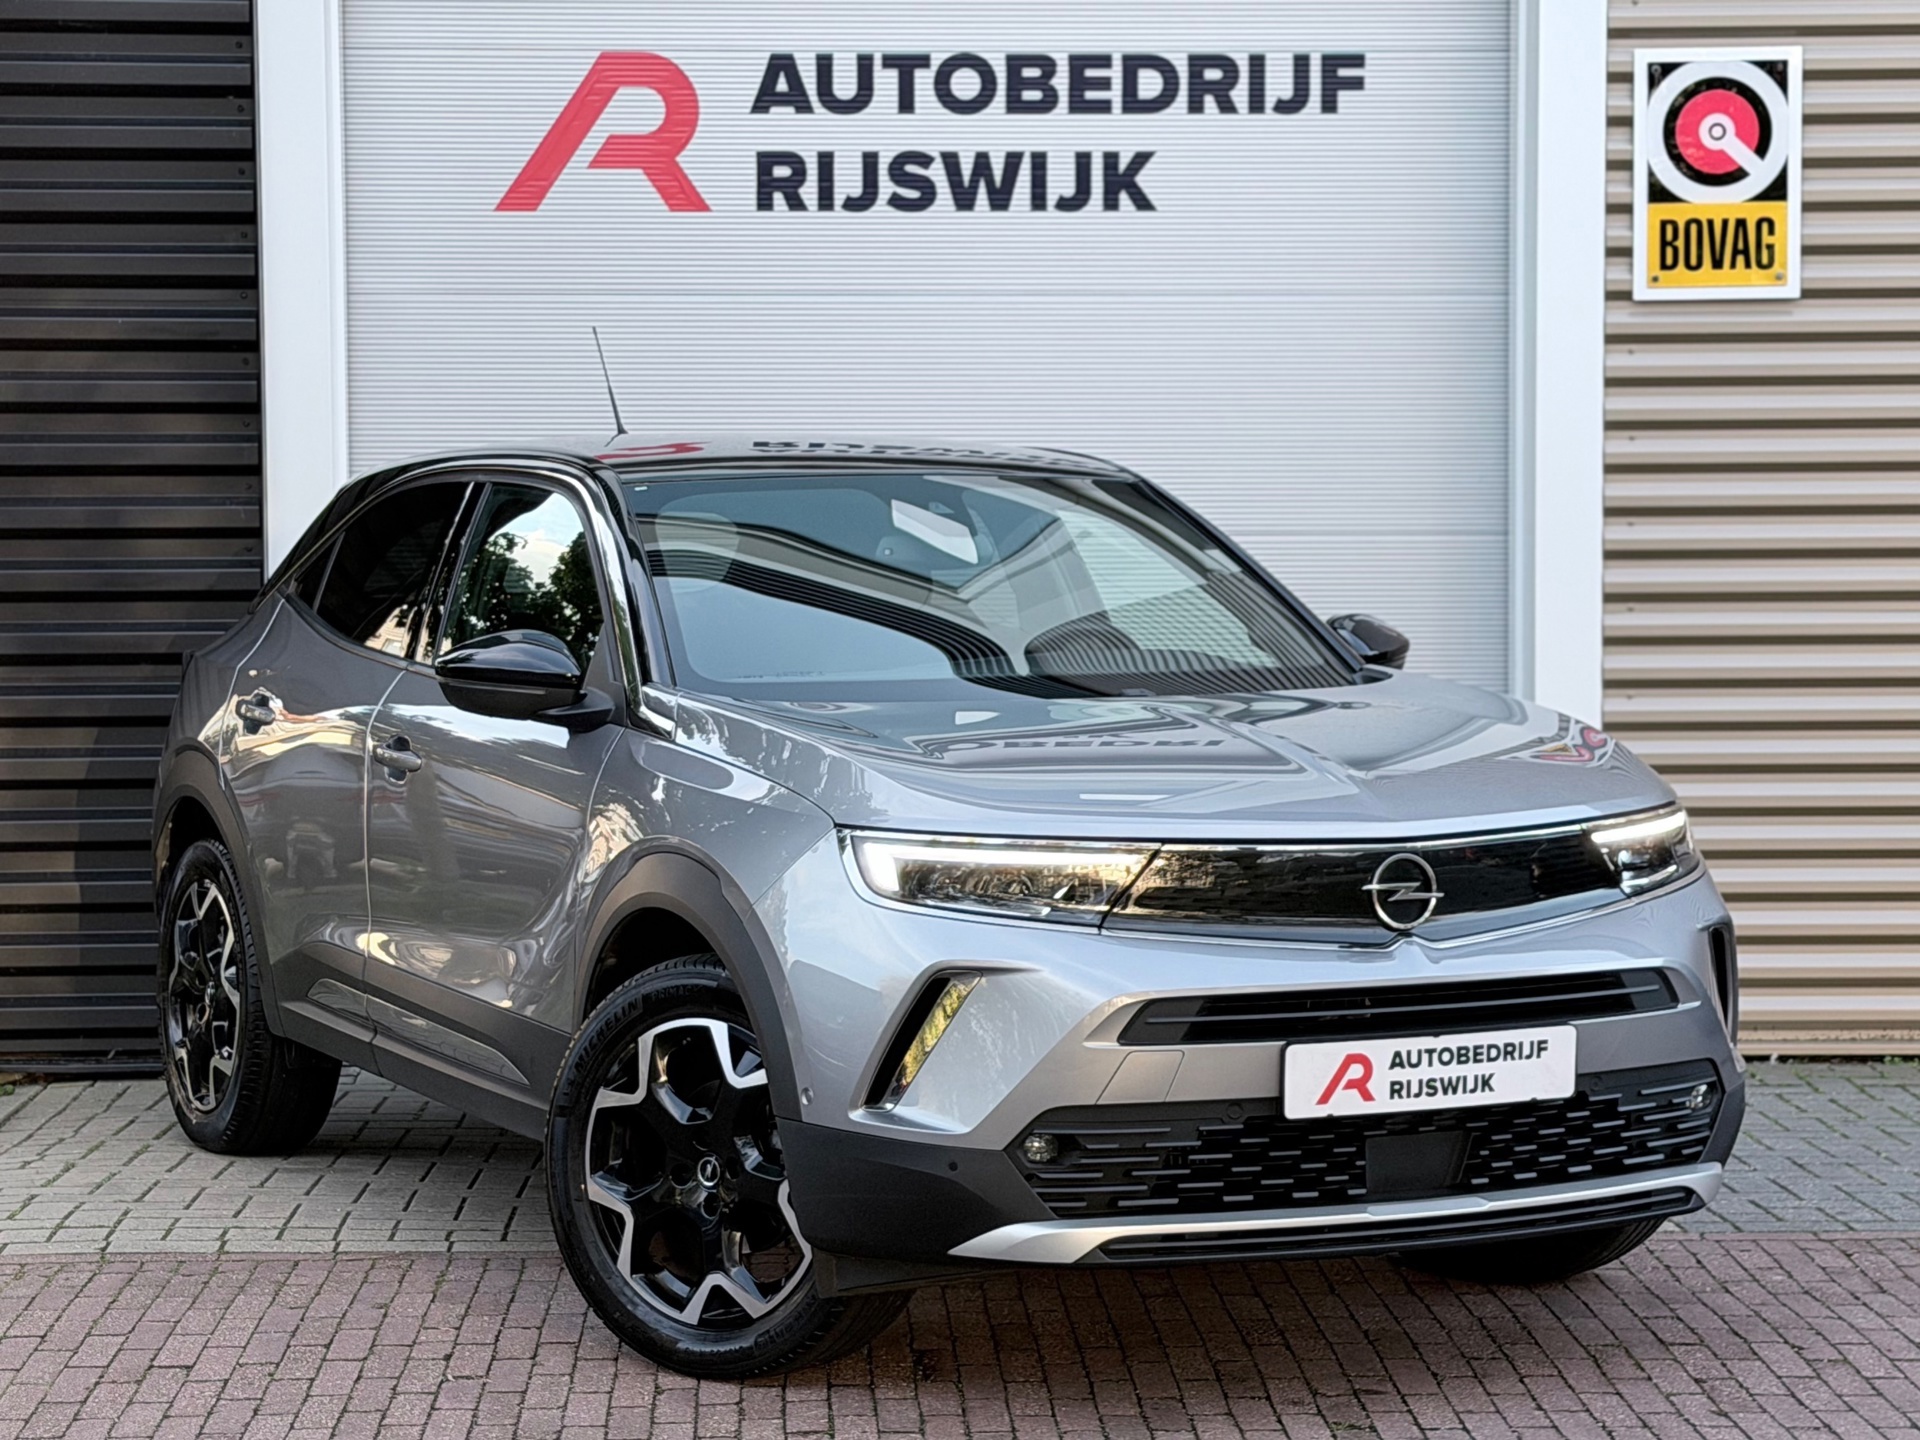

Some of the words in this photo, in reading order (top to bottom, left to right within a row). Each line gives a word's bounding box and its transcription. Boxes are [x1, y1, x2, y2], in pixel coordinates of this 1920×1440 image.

[750, 52, 1365, 115] AUTOBEDRIJF
[754, 151, 1156, 212] RIJSWIJK
[1659, 216, 1776, 271] BOVAG
[574, 997, 638, 1074] MICHELIN
[1388, 1039, 1549, 1071] AUTOBEDRIJF
[1389, 1073, 1496, 1100] RIJSWIJK
